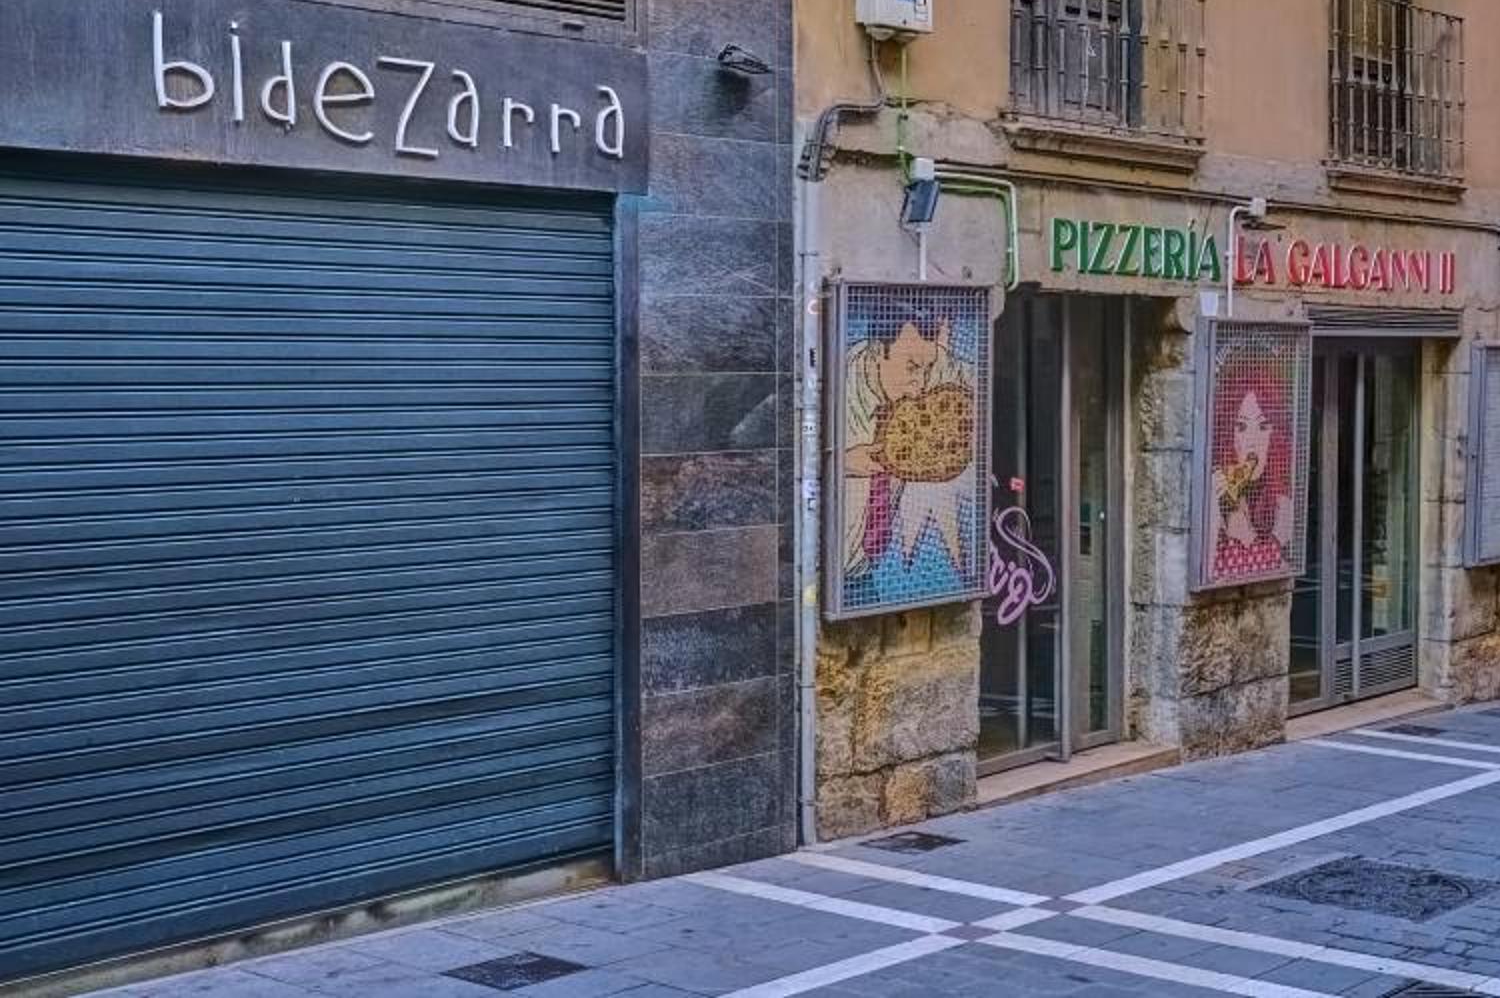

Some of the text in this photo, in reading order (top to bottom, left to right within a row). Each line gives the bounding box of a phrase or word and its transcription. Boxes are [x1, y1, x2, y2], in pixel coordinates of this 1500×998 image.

[1050, 217, 1456, 295] PIZZERÍA LA GALGANNI II
